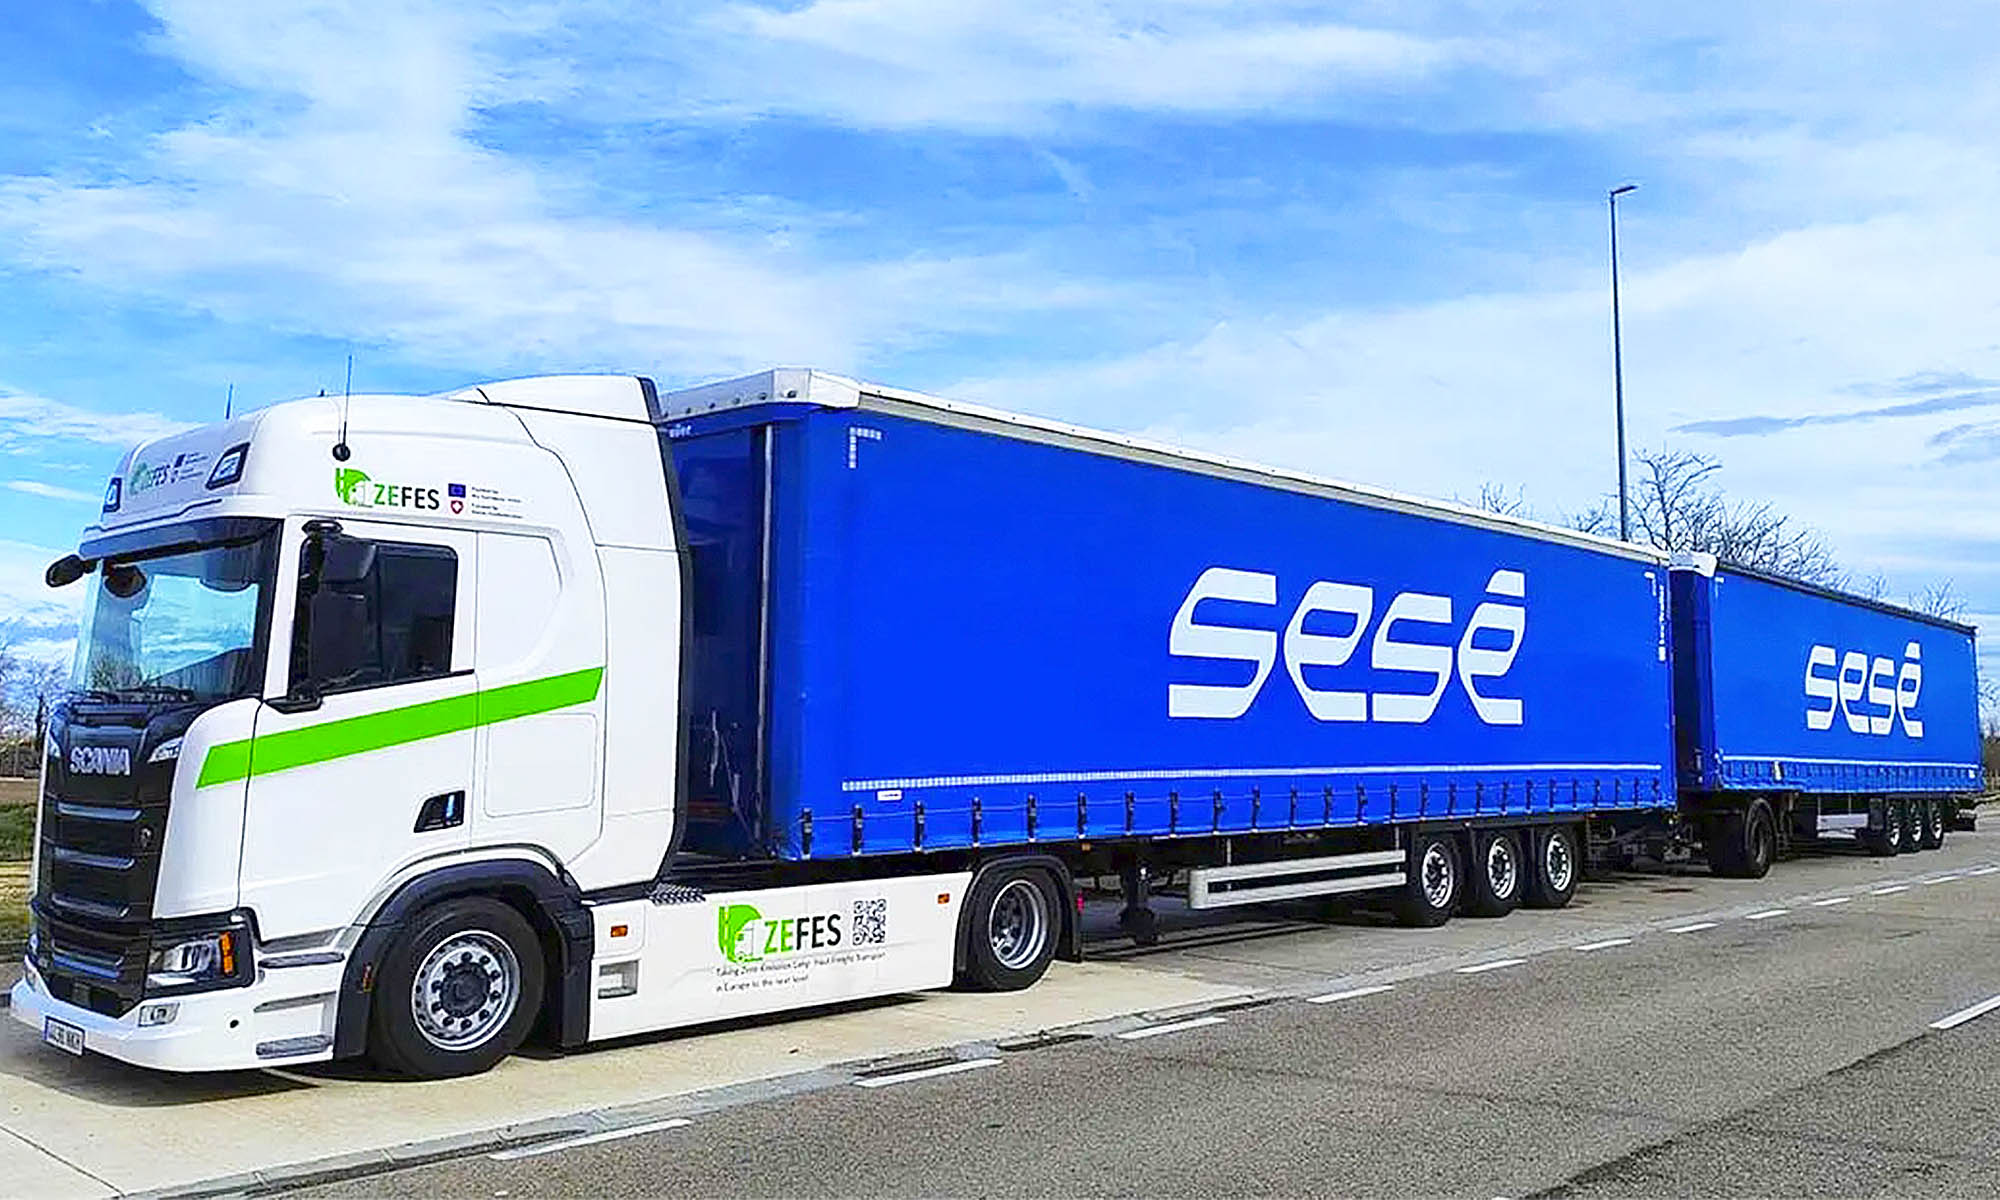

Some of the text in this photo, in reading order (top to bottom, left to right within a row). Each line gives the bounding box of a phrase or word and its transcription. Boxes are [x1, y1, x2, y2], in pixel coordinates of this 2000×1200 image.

[374, 484, 440, 510] ZEFES
[69, 746, 131, 776] SCANIA
[764, 914, 841, 954] ZEFES
